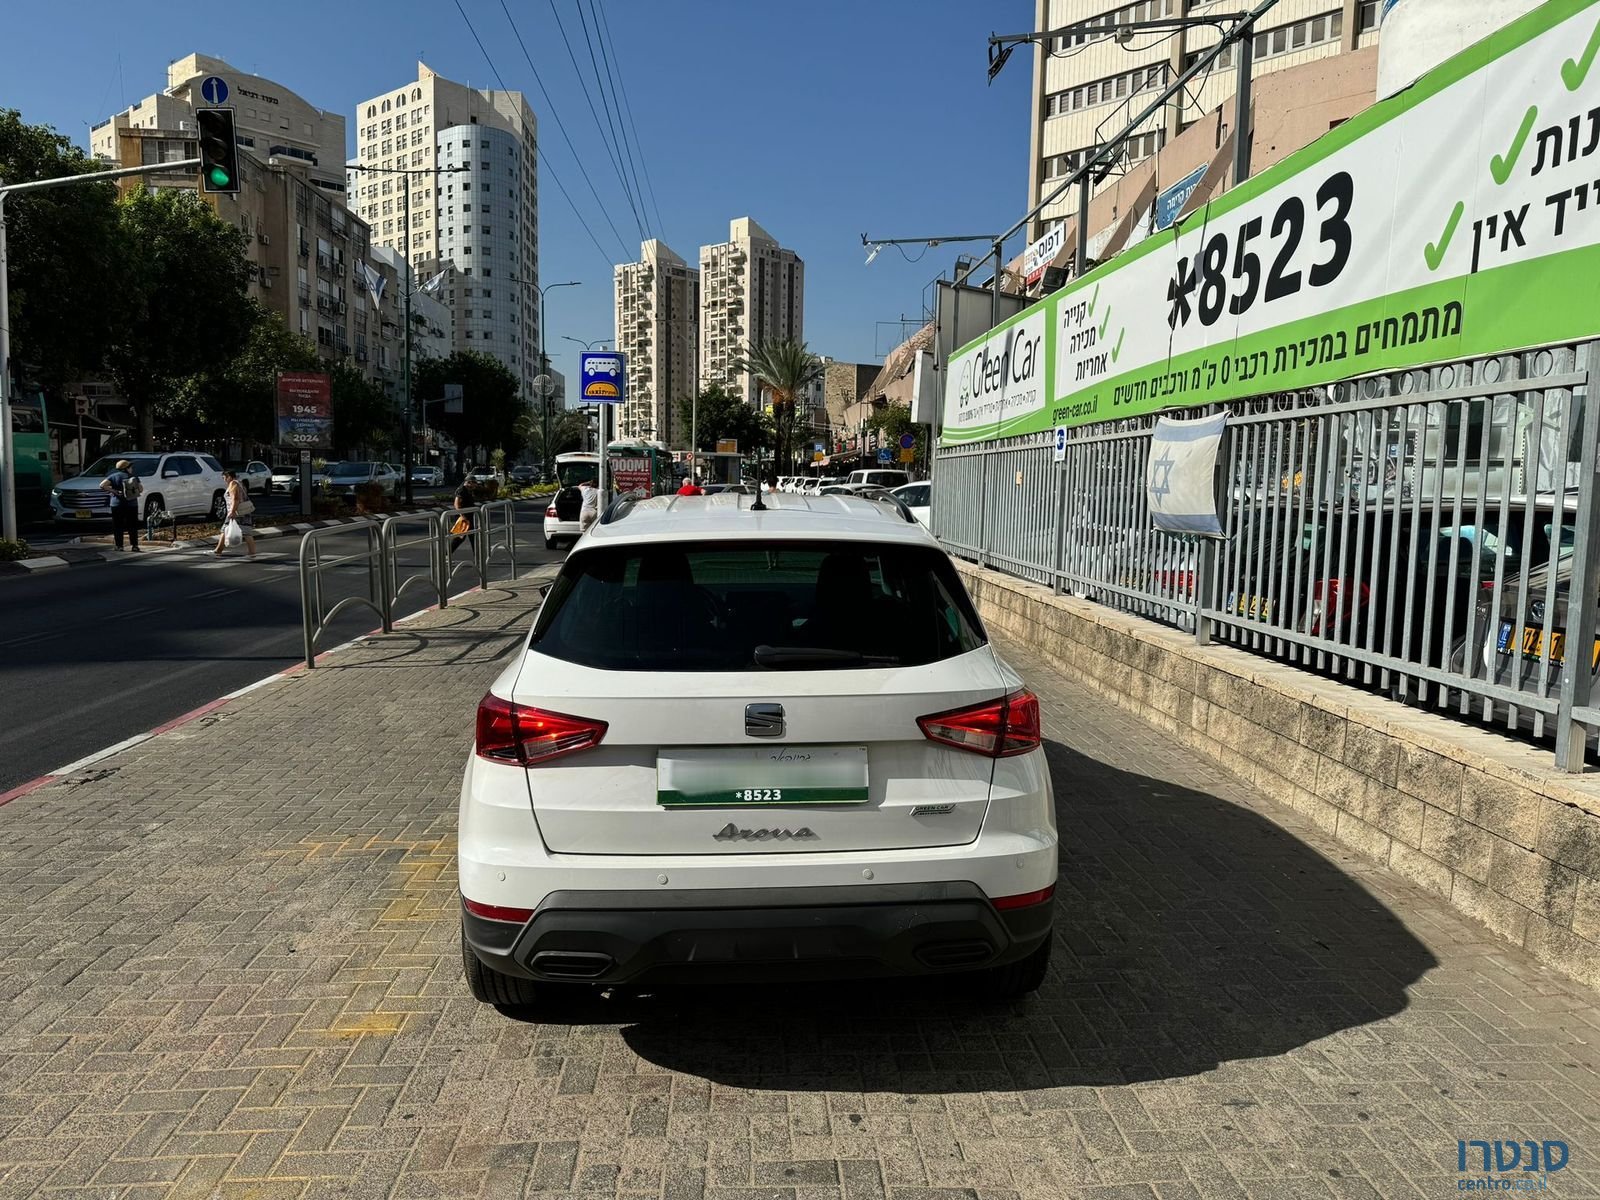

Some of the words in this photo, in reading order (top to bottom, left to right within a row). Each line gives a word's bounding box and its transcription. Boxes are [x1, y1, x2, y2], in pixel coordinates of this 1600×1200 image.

[1038, 230, 1060, 258] דפוס
[1471, 203, 1531, 274] אין
[1063, 300, 1087, 329] קנייה
[1355, 300, 1462, 354] מתמחים
[1069, 325, 1097, 354] מכירה
[1273, 331, 1348, 375] במכירת
[973, 350, 1009, 398] Green
[1012, 328, 1041, 383] Car
[1075, 352, 1108, 382] אחריות
[1221, 355, 1231, 385] 0
[1234, 347, 1268, 381] רכבי
[1113, 380, 1147, 406] חדשים
[1150, 370, 1188, 400] ורכבים
[292, 405, 317, 414] 1945
[1052, 396, 1098, 425] green-car.co.il
[293, 434, 320, 442] 2024
[712, 822, 821, 842] Arona
